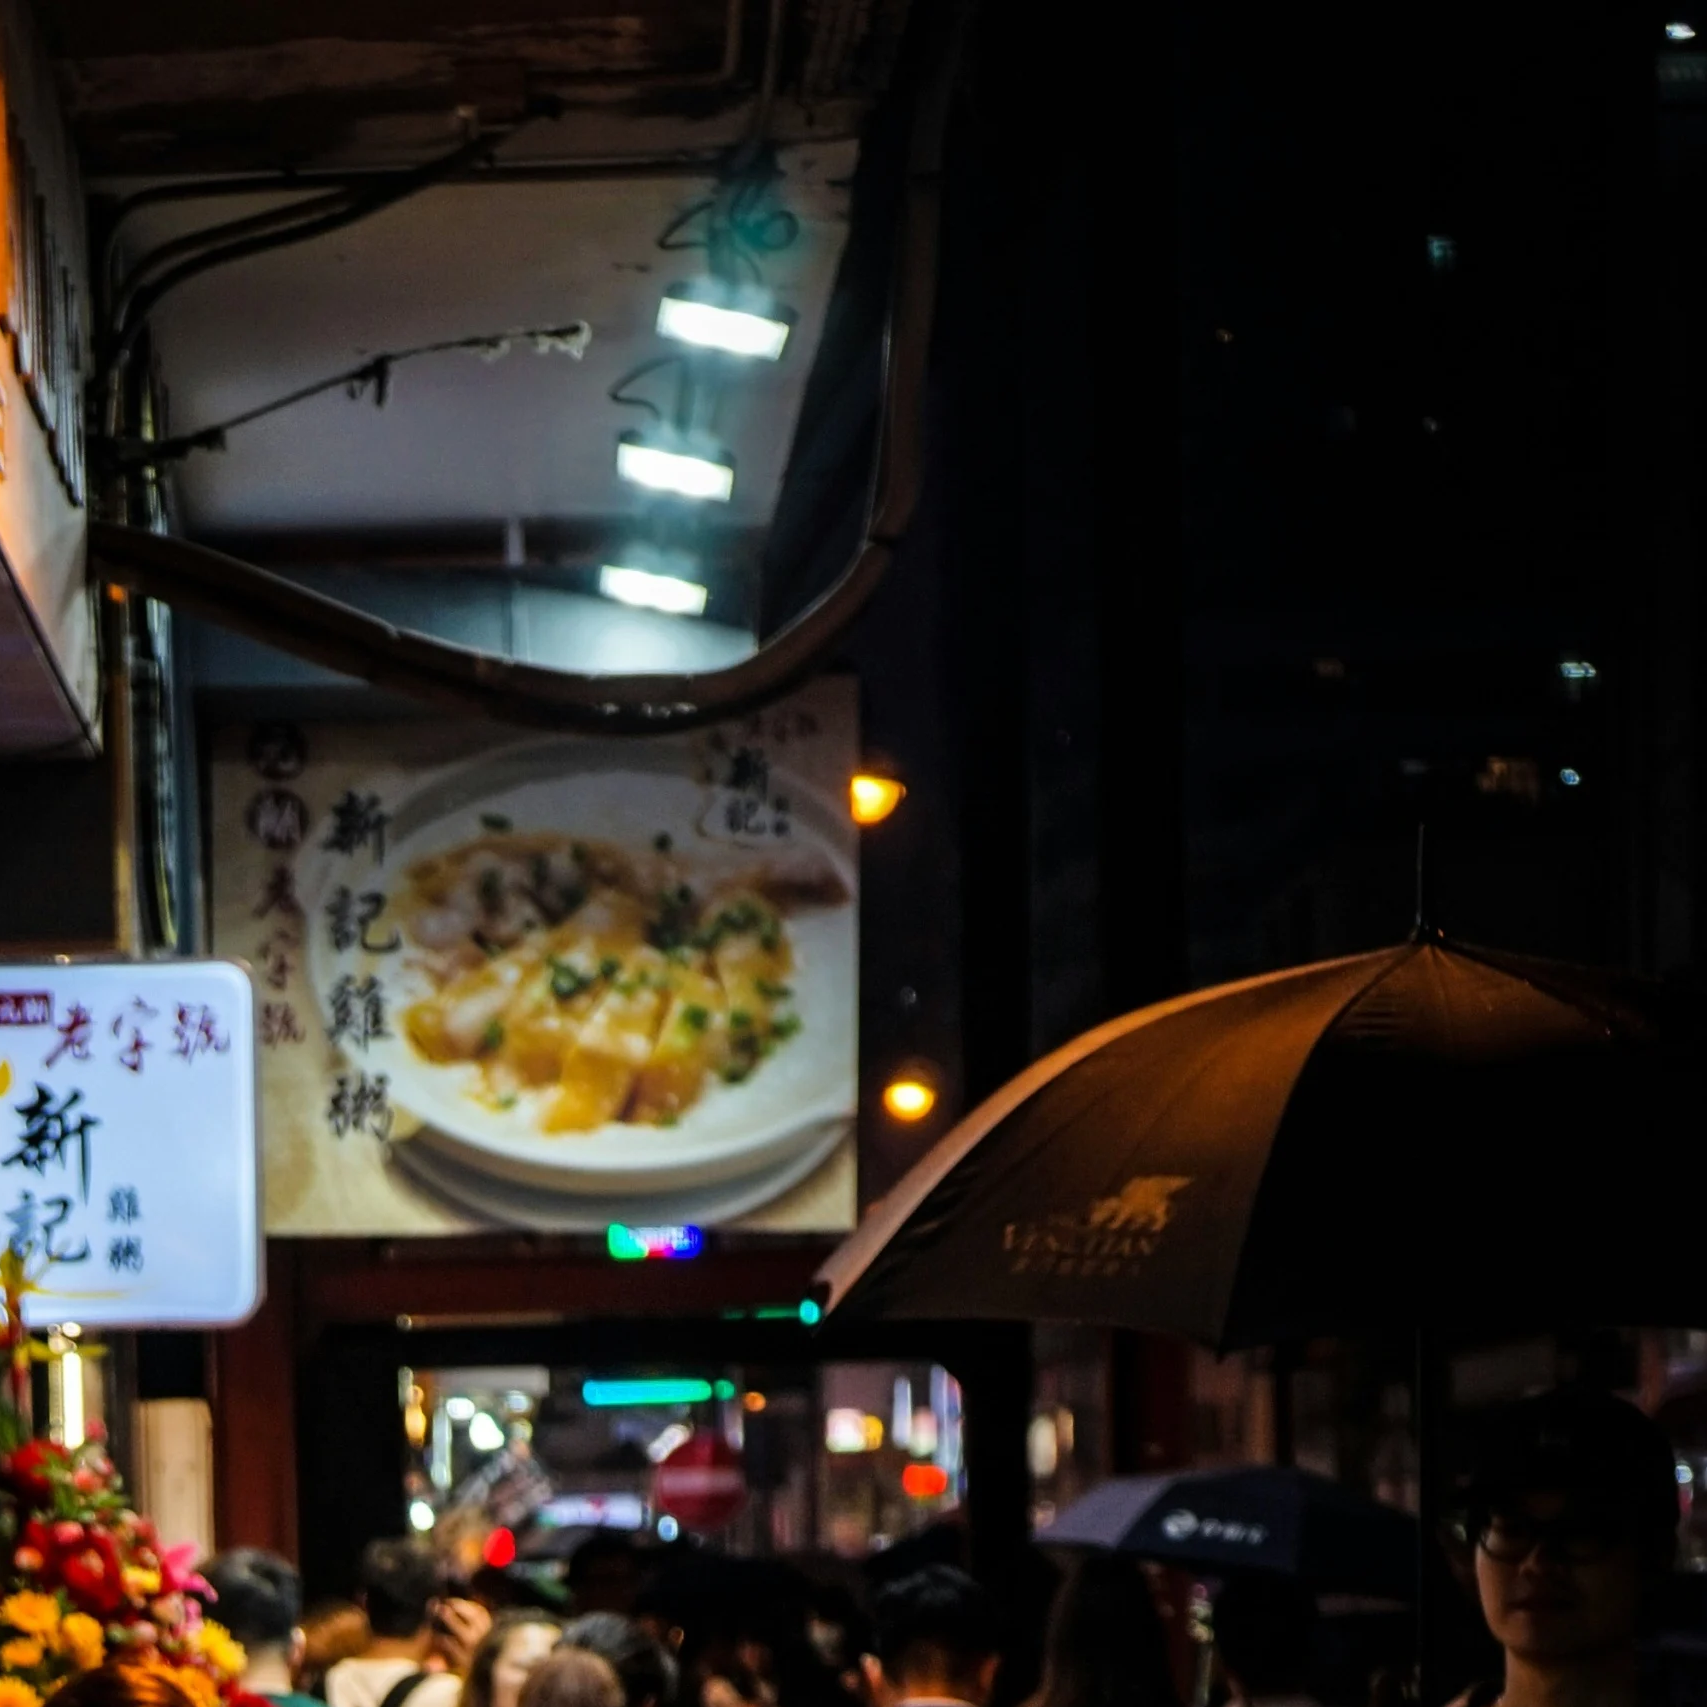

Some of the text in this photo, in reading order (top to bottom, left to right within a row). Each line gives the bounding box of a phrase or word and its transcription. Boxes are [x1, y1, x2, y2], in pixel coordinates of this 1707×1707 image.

[45, 995, 231, 1073] 老字號
[324, 790, 401, 1141] 新記雞粥
[1, 1081, 102, 1264] 新記
